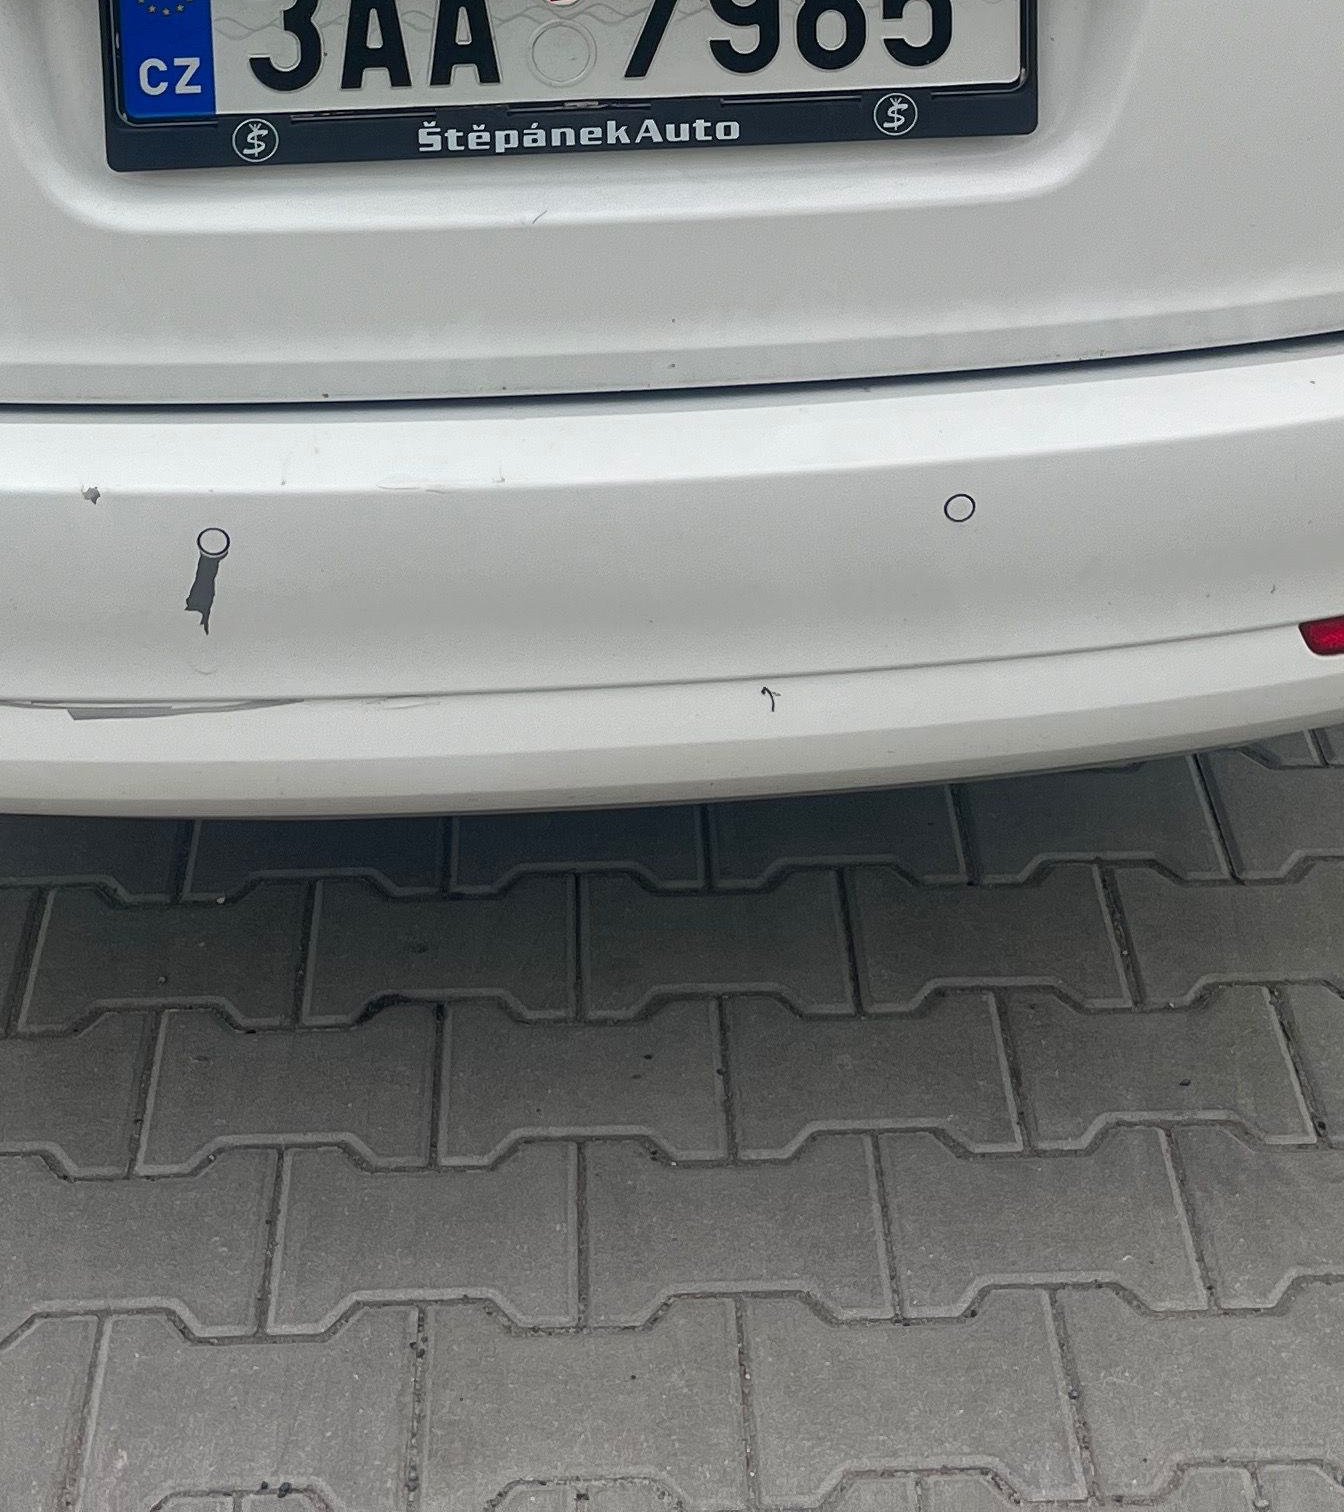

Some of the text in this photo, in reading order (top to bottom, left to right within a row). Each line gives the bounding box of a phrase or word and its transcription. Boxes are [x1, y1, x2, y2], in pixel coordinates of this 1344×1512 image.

[138, 56, 202, 96] CZ
[418, 120, 630, 153] Štěpánek
[634, 119, 740, 144] Auto
